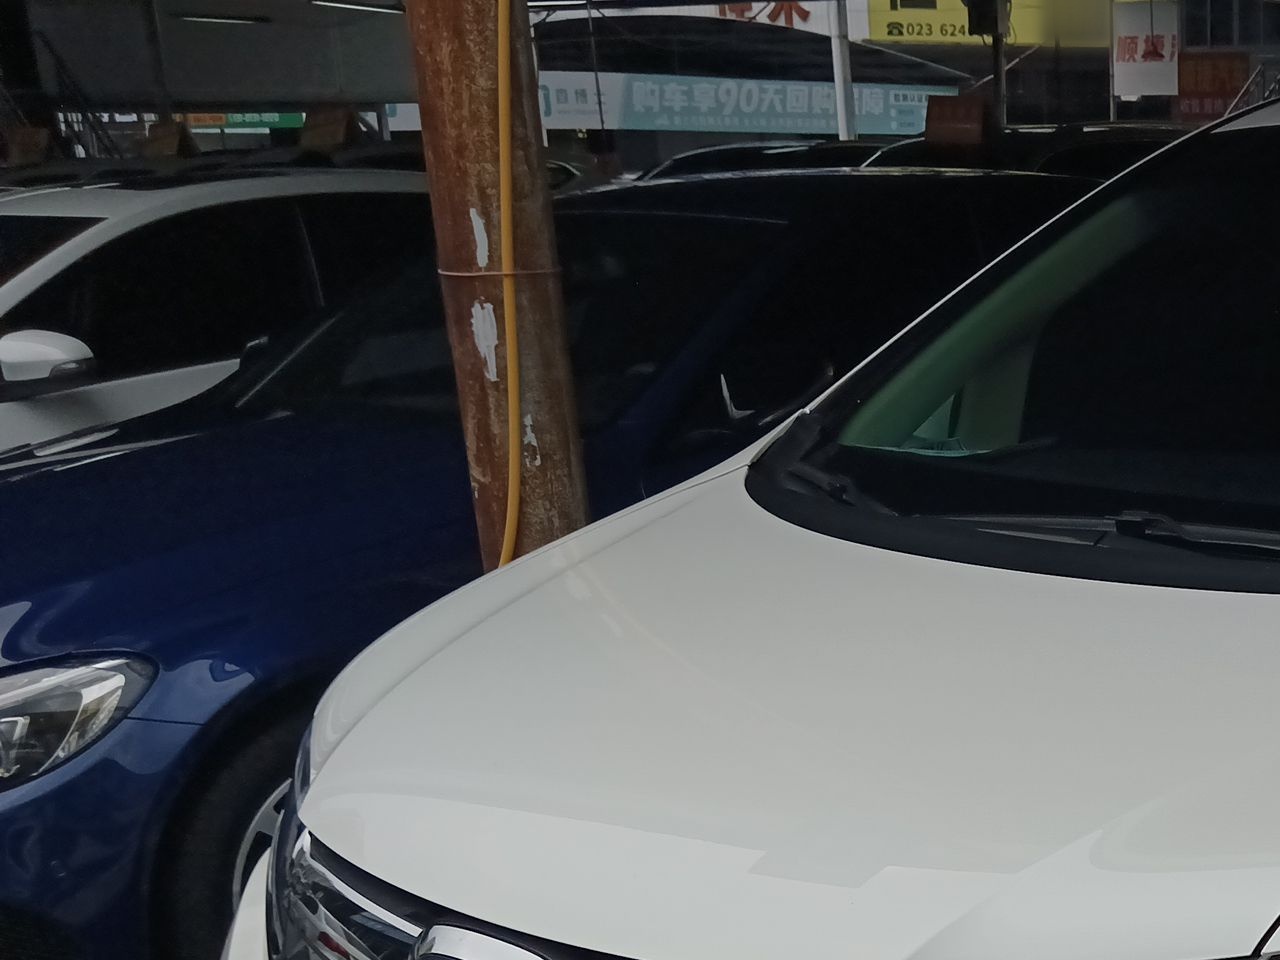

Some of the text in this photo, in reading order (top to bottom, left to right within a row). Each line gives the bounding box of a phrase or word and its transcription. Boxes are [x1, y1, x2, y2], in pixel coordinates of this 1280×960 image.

[906, 23, 933, 36] 023
[1116, 34, 1177, 63] 顺捷
[632, 81, 884, 115] 购车享90天回购障
